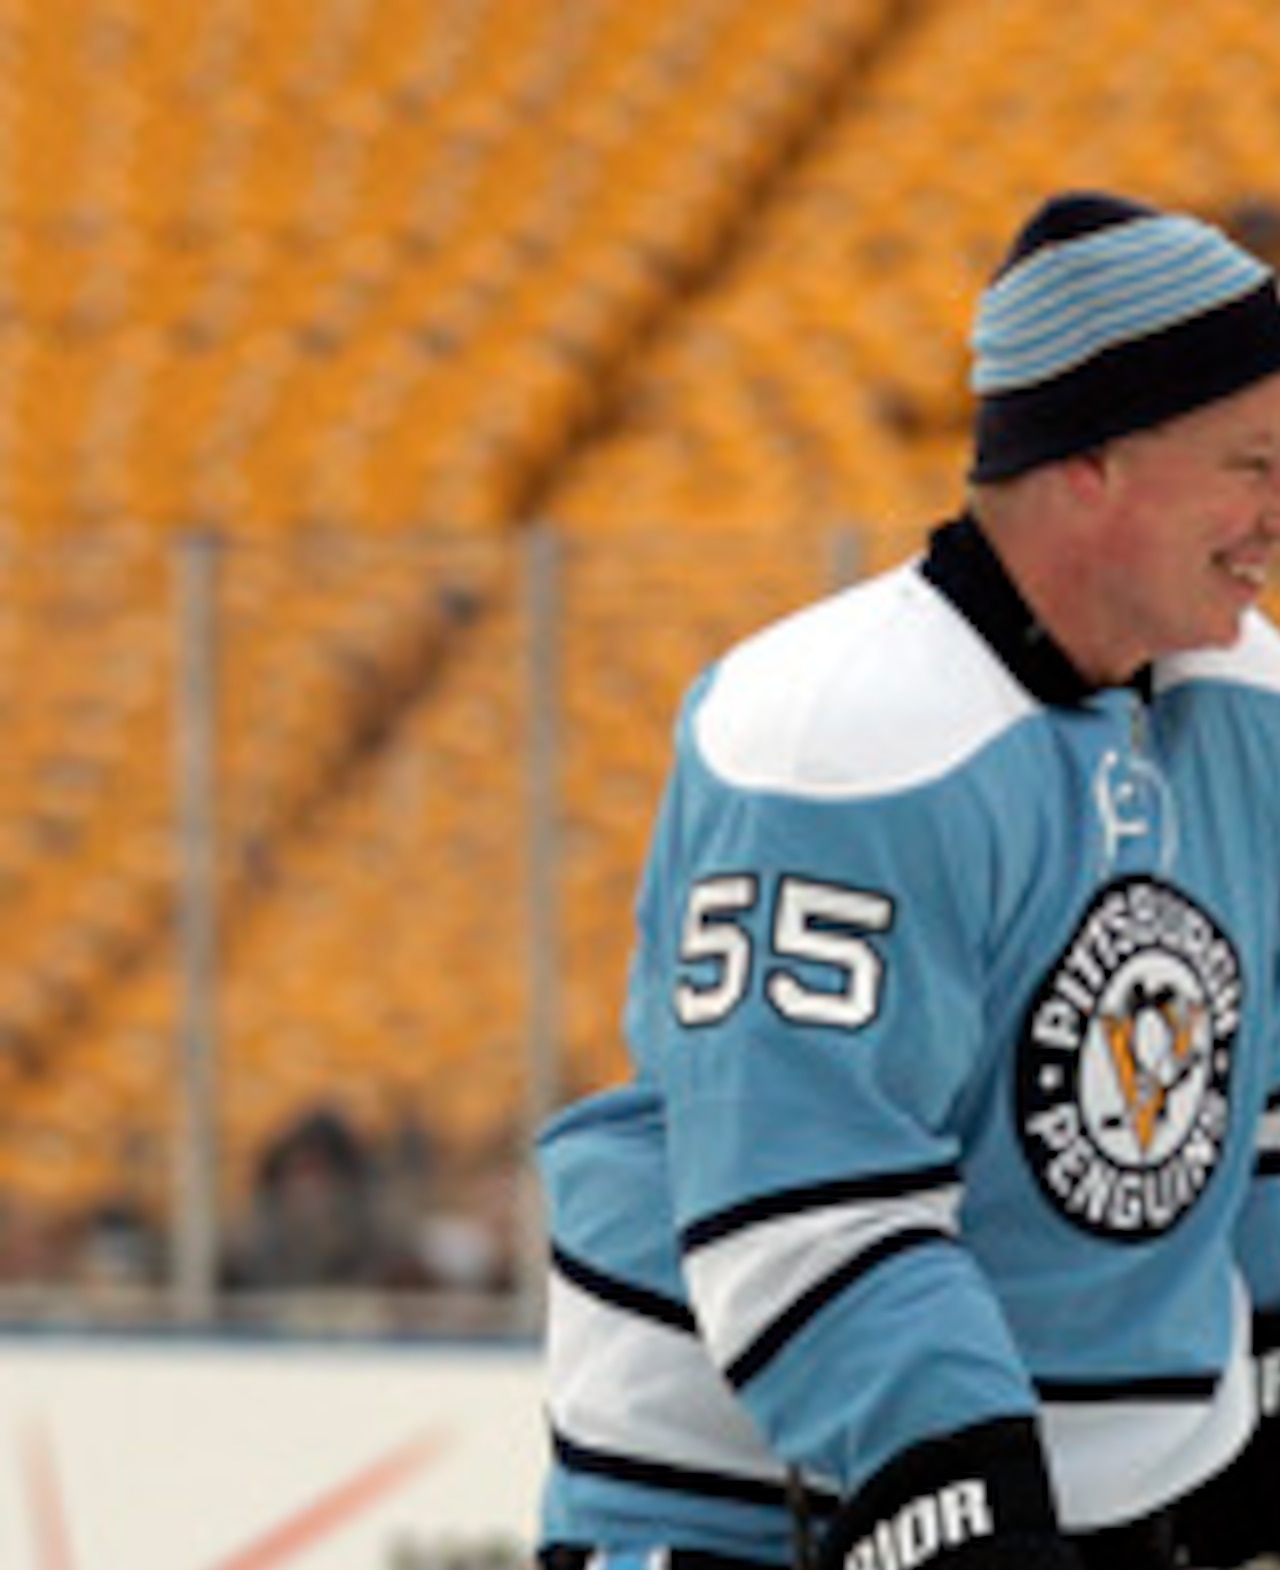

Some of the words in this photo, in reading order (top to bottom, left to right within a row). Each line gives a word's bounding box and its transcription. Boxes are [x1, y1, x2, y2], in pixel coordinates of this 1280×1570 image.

[672, 872, 894, 1030] 55
[1031, 880, 1242, 1050] PITTSBURGH
[1024, 1088, 1228, 1231] PENGUINS
